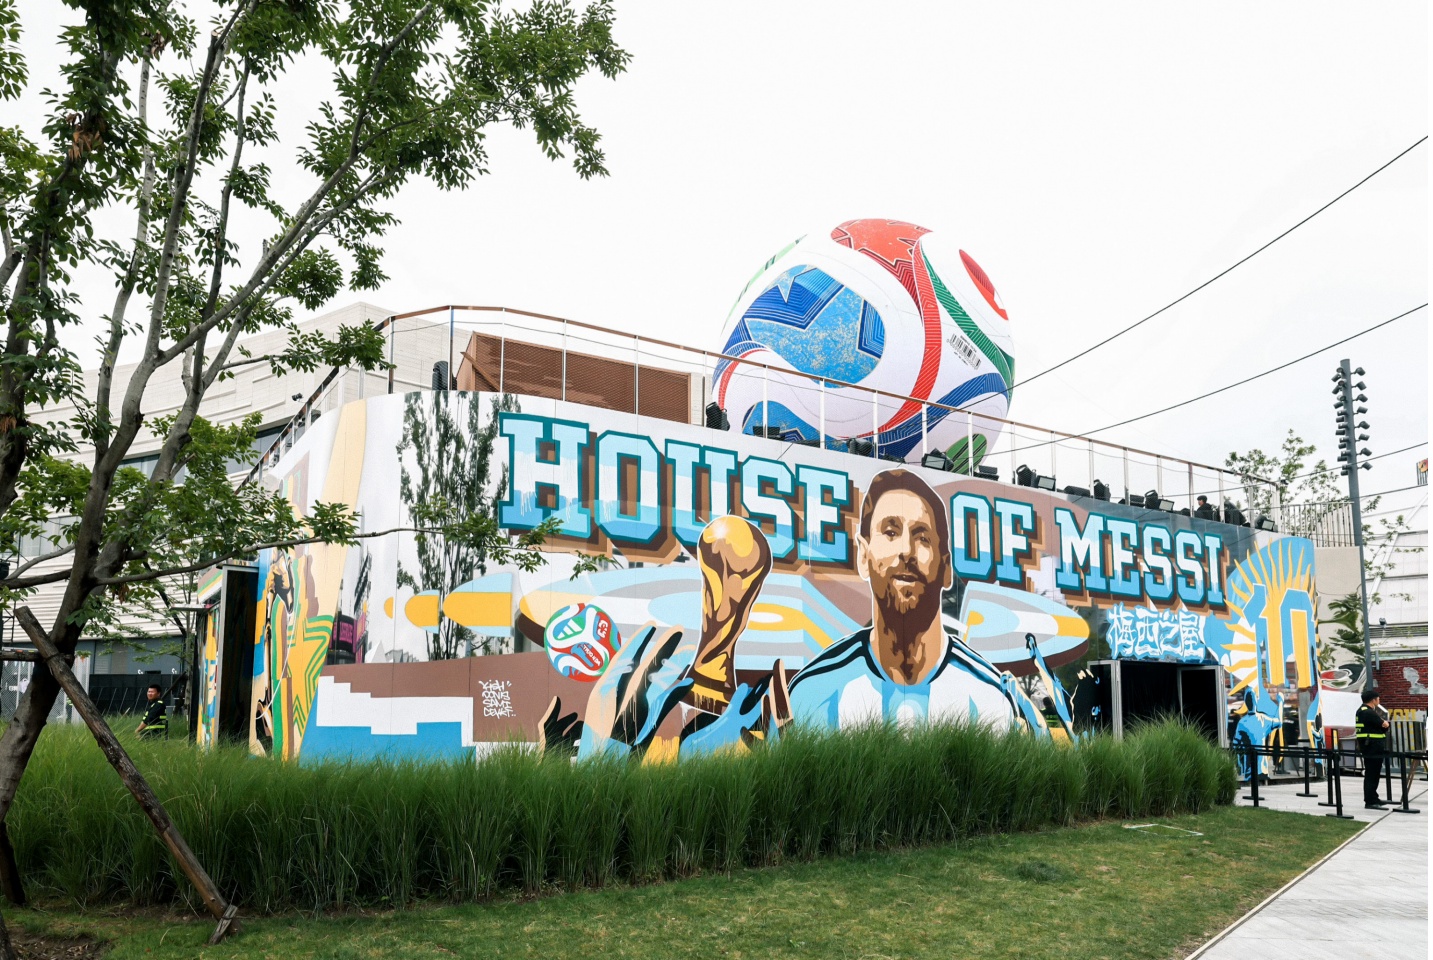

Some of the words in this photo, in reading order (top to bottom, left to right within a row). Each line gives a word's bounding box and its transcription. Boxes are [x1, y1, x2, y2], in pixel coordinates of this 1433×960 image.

[499, 411, 849, 562] HOUSE
[950, 491, 1034, 583] OF
[1054, 507, 1225, 606] MESSI
[1107, 603, 1205, 660] 梅西之屋
[1243, 583, 1316, 700] 10
